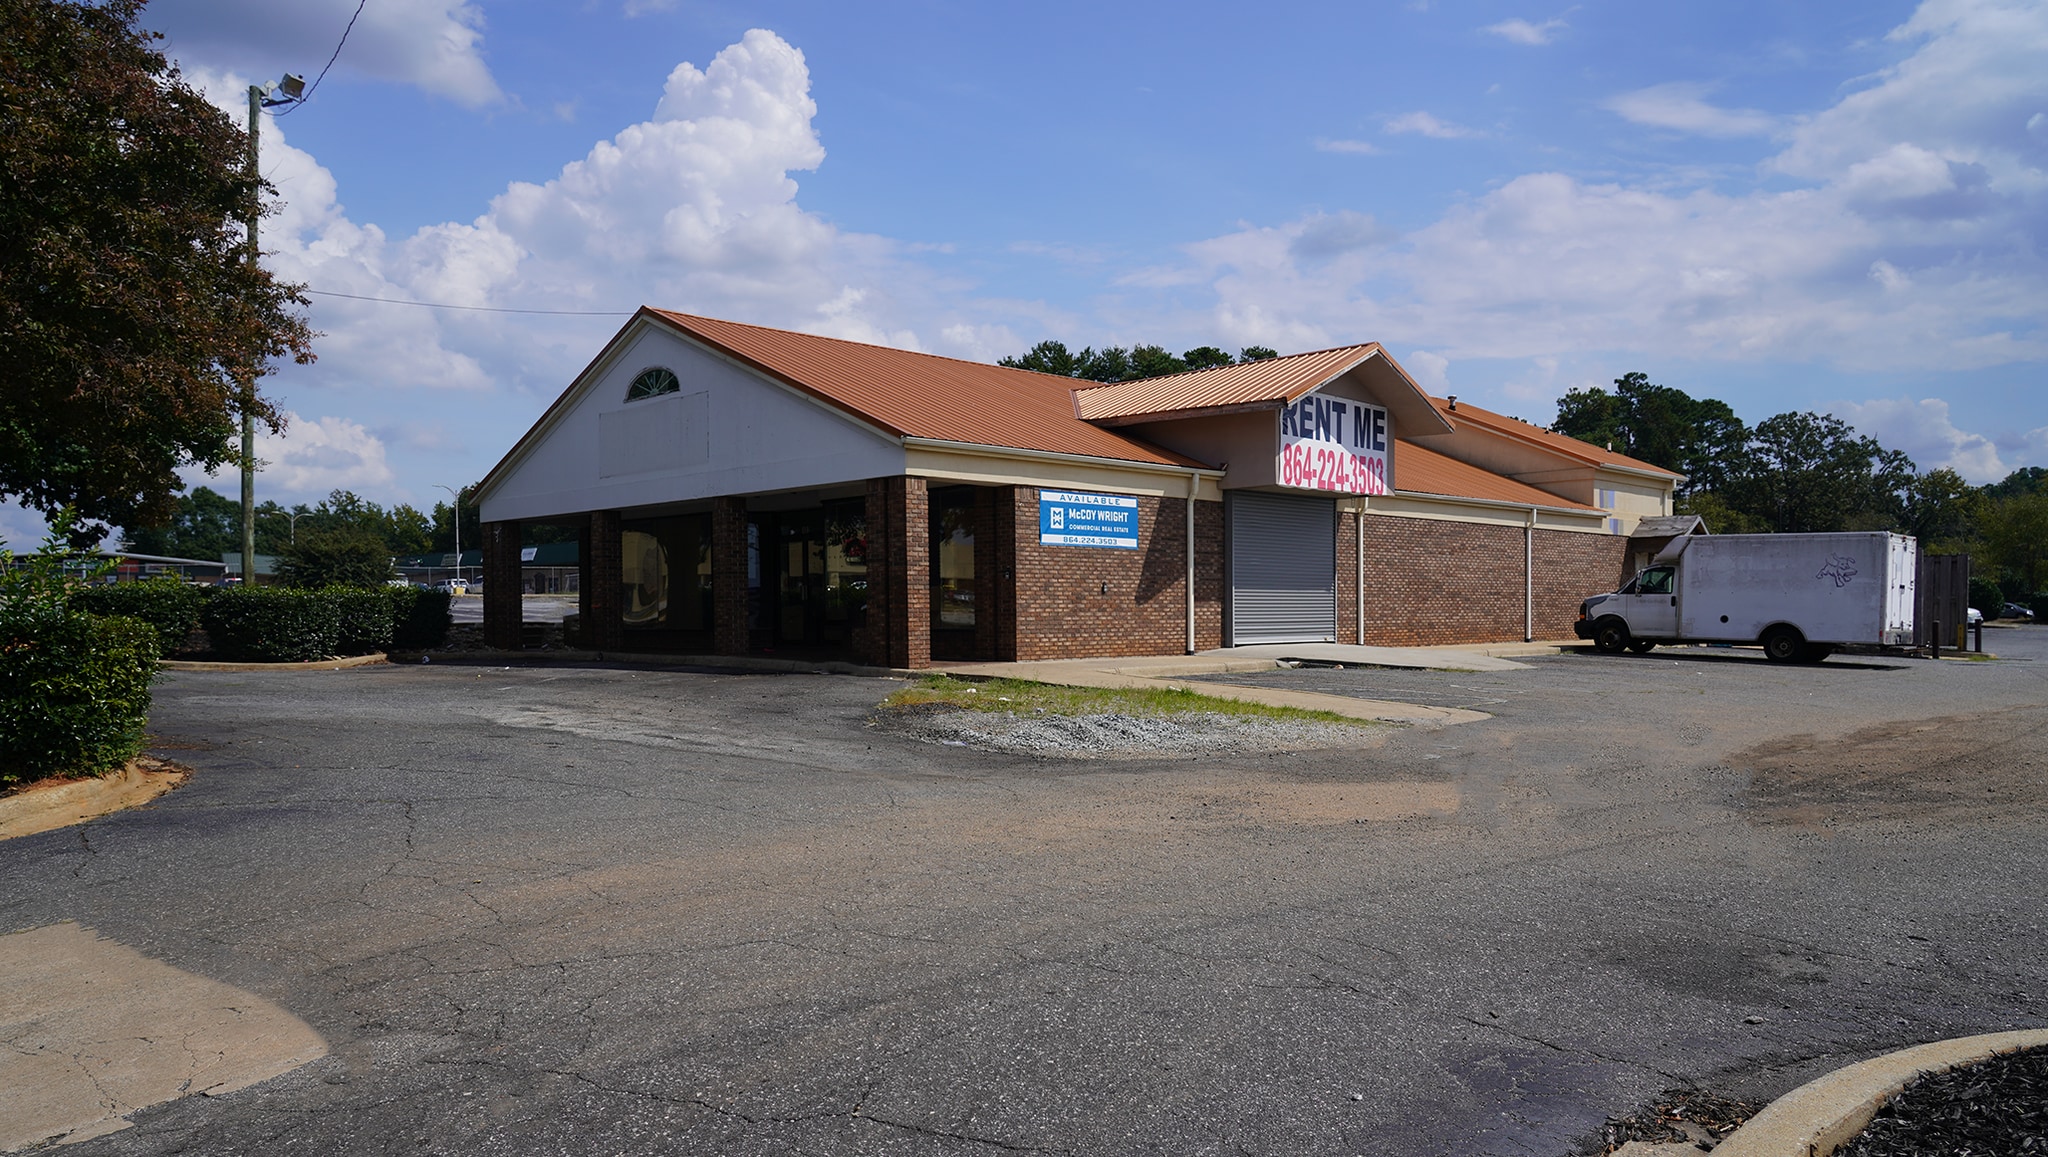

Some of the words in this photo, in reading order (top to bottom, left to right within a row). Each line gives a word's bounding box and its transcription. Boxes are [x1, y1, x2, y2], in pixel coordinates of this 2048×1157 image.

[1354, 405, 1386, 451] ME
[1283, 442, 1384, 496] 864-224-3503
[1060, 494, 1120, 505] AVAILABLE
[1069, 508, 1096, 520] McCOY
[1097, 510, 1128, 522] WRIGHT
[1069, 524, 1100, 532] COMMERCIAL
[1063, 536, 1117, 545] 864.224.3503
